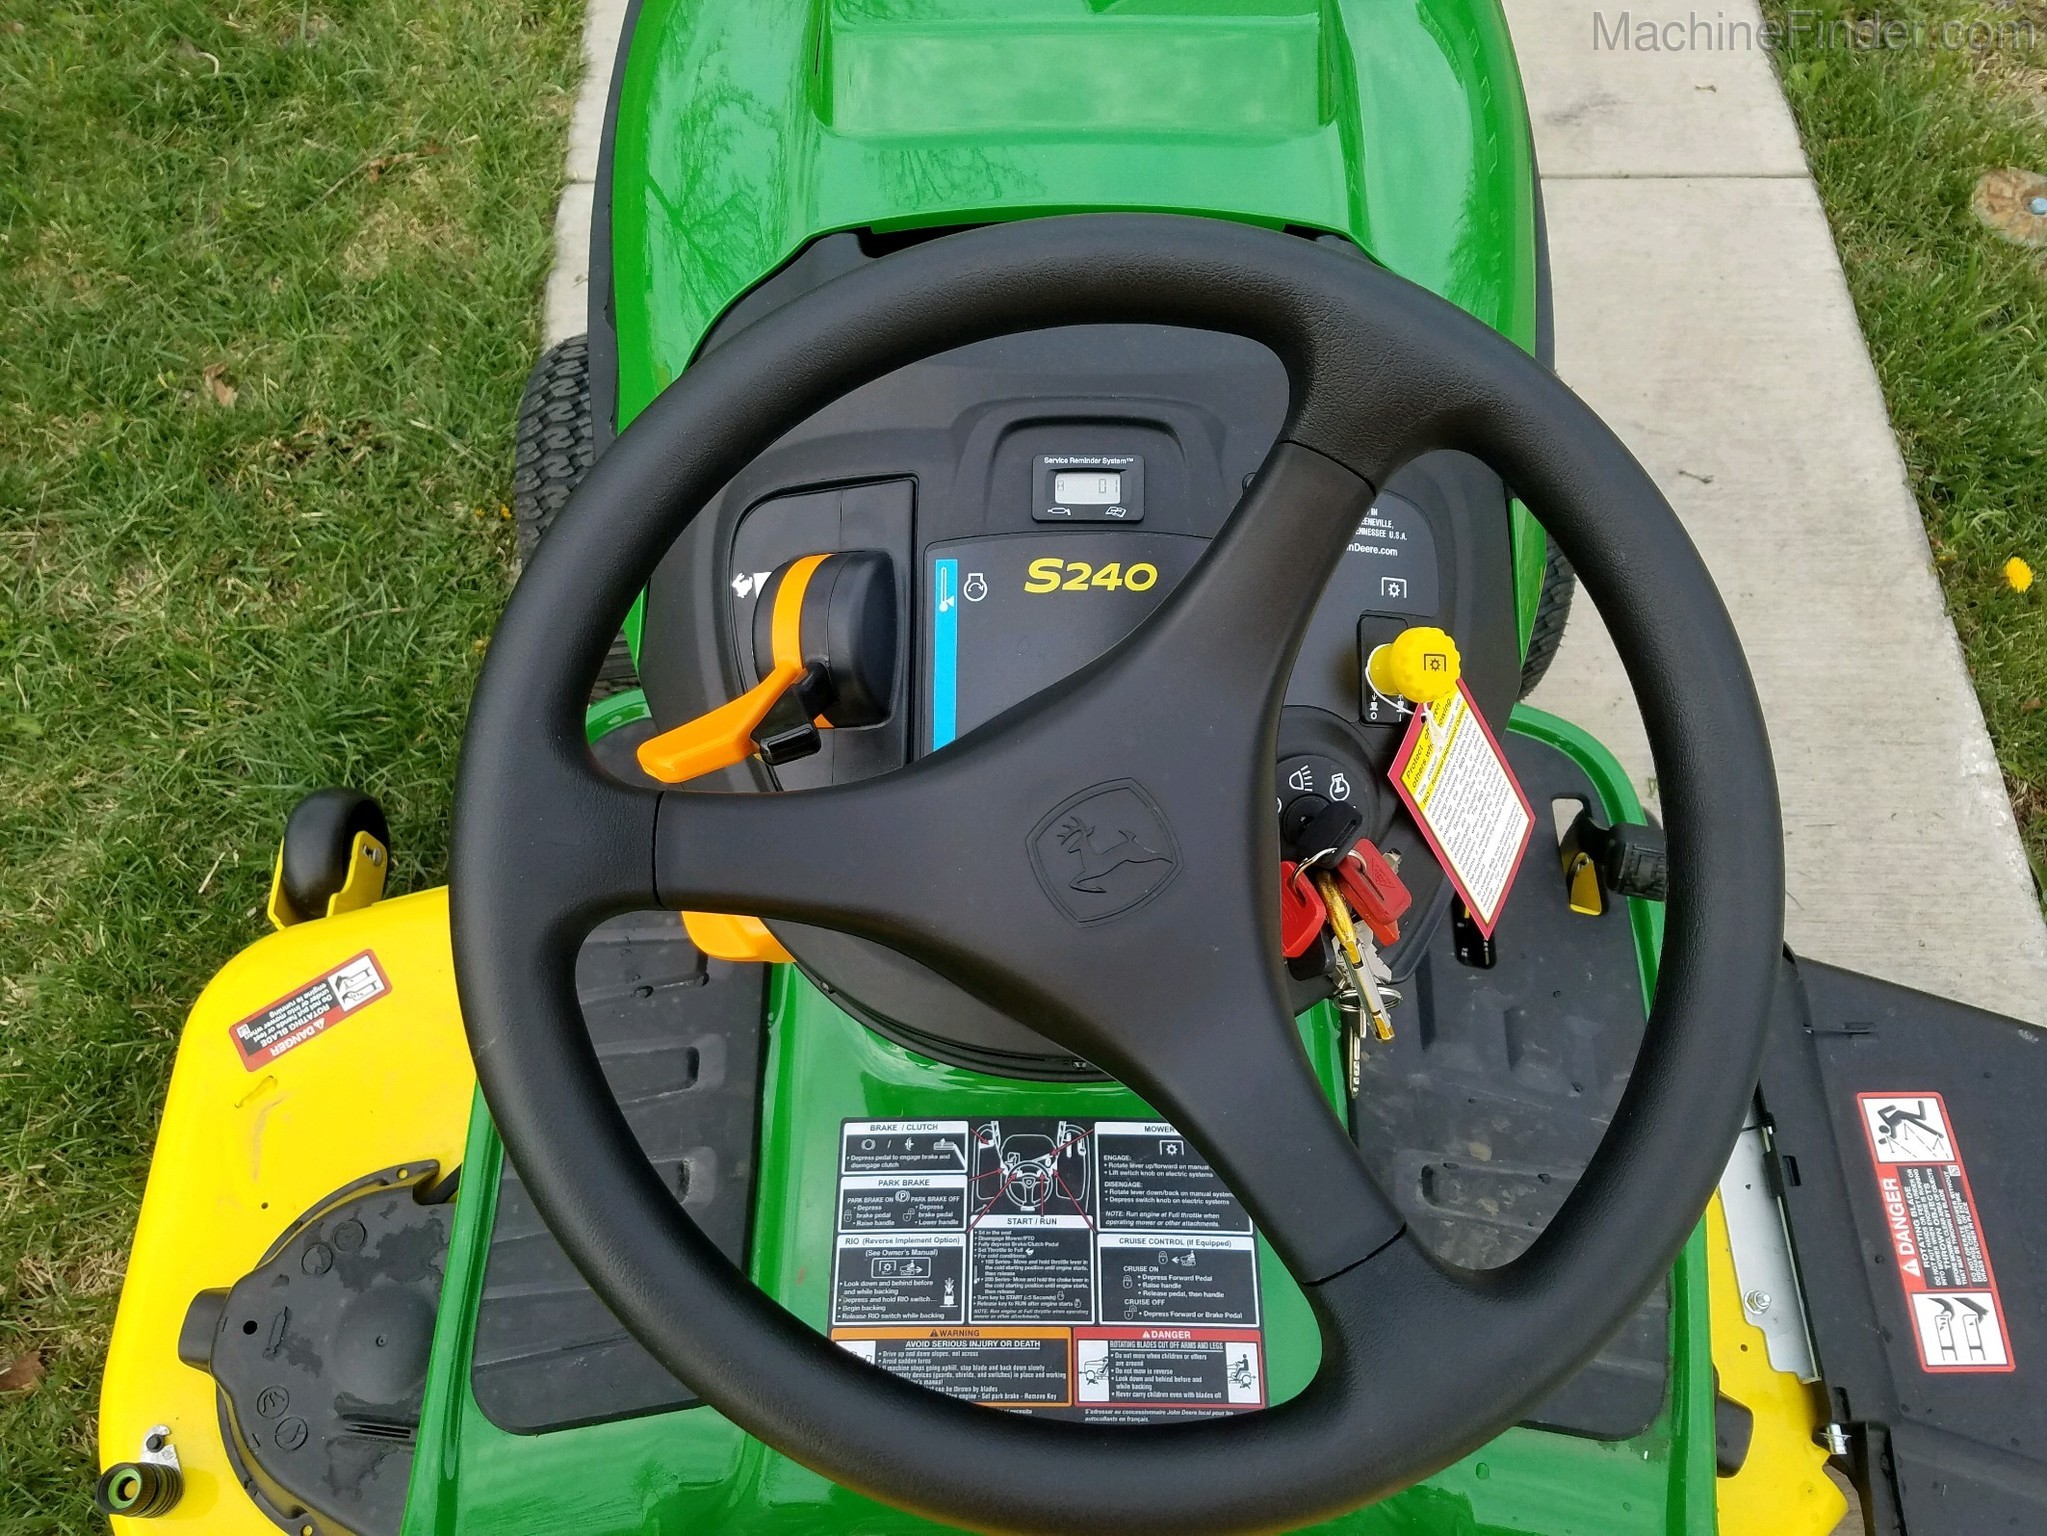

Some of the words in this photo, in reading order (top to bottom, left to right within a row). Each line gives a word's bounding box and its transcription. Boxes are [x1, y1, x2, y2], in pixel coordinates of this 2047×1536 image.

[1356, 527, 1386, 538] ENNESSEE
[1389, 531, 1407, 540] U.S.A.
[1361, 517, 1394, 529] EENEVILLE,
[1024, 558, 1157, 593] S240
[1406, 744, 1424, 780] Protect
[1411, 759, 1426, 788] others
[286, 1002, 330, 1031] ROTATING
[259, 1026, 288, 1047] BLADE
[268, 1024, 315, 1056] DANGER
[878, 1179, 900, 1187] PARK
[857, 1204, 882, 1212] Depress
[1904, 1186, 1918, 1217] BLADE
[1923, 1182, 1940, 1226] OBJECTS
[1882, 1178, 1915, 1255] DANGER
[863, 1237, 893, 1245] (Reverse
[865, 1249, 880, 1257] (See
[1149, 1238, 1185, 1246] CONTROL
[1187, 1239, 1196, 1247] (If
[1195, 1239, 1232, 1247] Equipped)
[1913, 1220, 1931, 1268] ROTATING
[1936, 1228, 1951, 1270] THROWN
[1137, 1341, 1157, 1349] BLADES
[1151, 1331, 1191, 1339] DANGER
